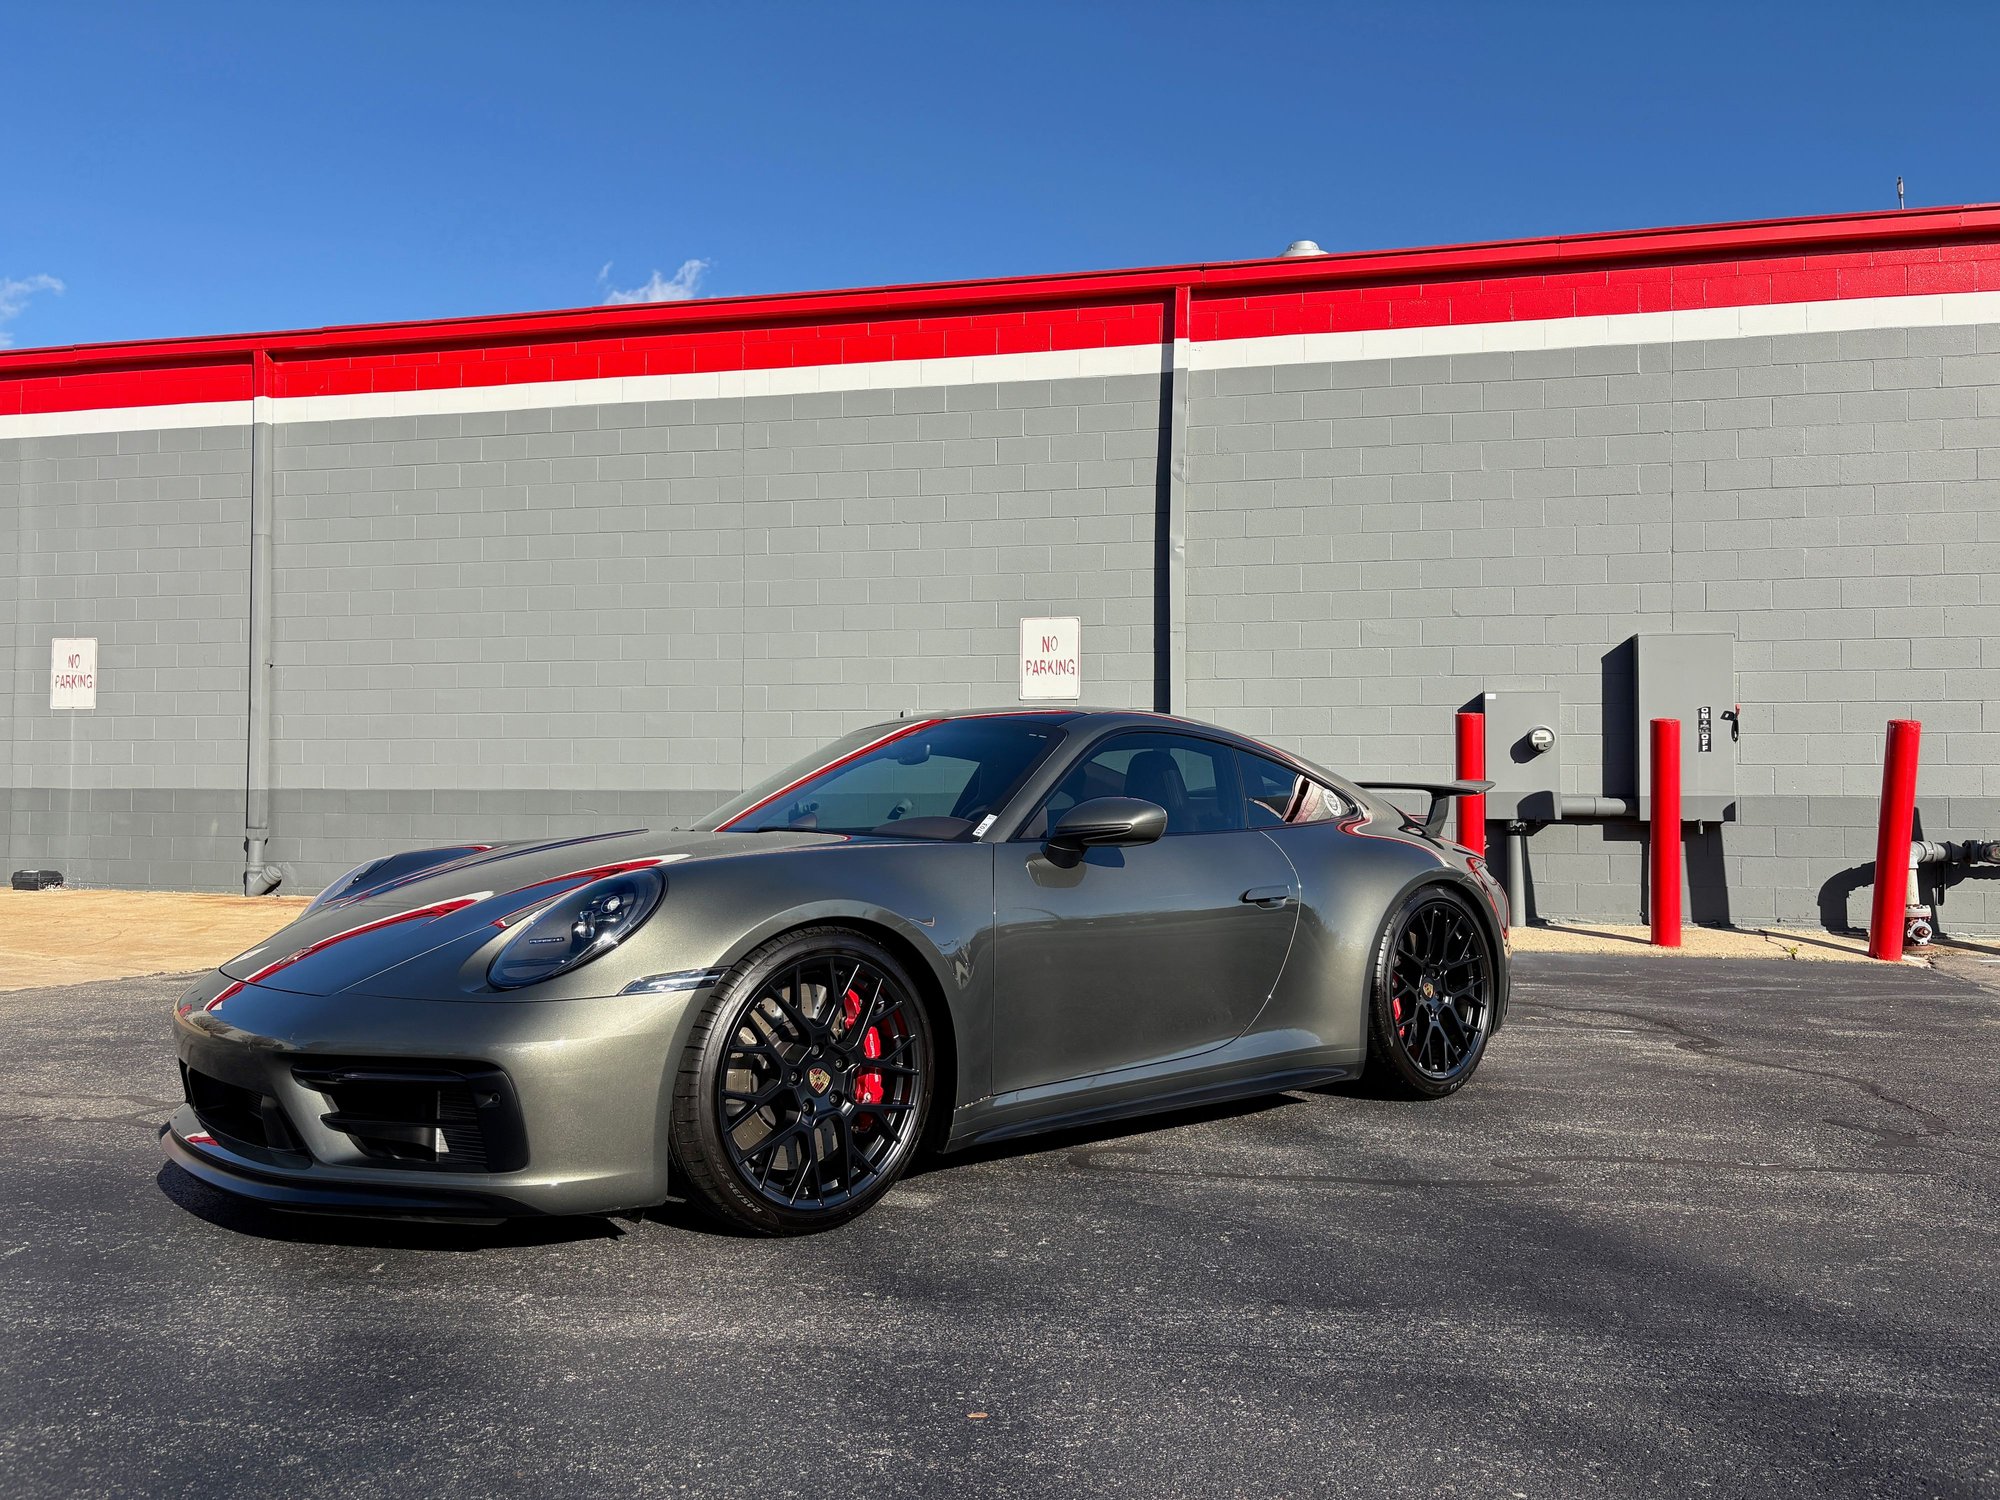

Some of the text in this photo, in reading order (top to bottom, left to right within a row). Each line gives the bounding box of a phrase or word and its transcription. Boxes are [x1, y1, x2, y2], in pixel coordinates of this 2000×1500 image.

[1042, 635, 1058, 653] NO
[68, 653, 80, 668] NO
[1025, 659, 1075, 676] PARKING
[55, 673, 93, 689] PARKING
[1701, 707, 1709, 719] ON
[1701, 733, 1709, 752] OFF
[727, 1182, 762, 1214] 245/35
